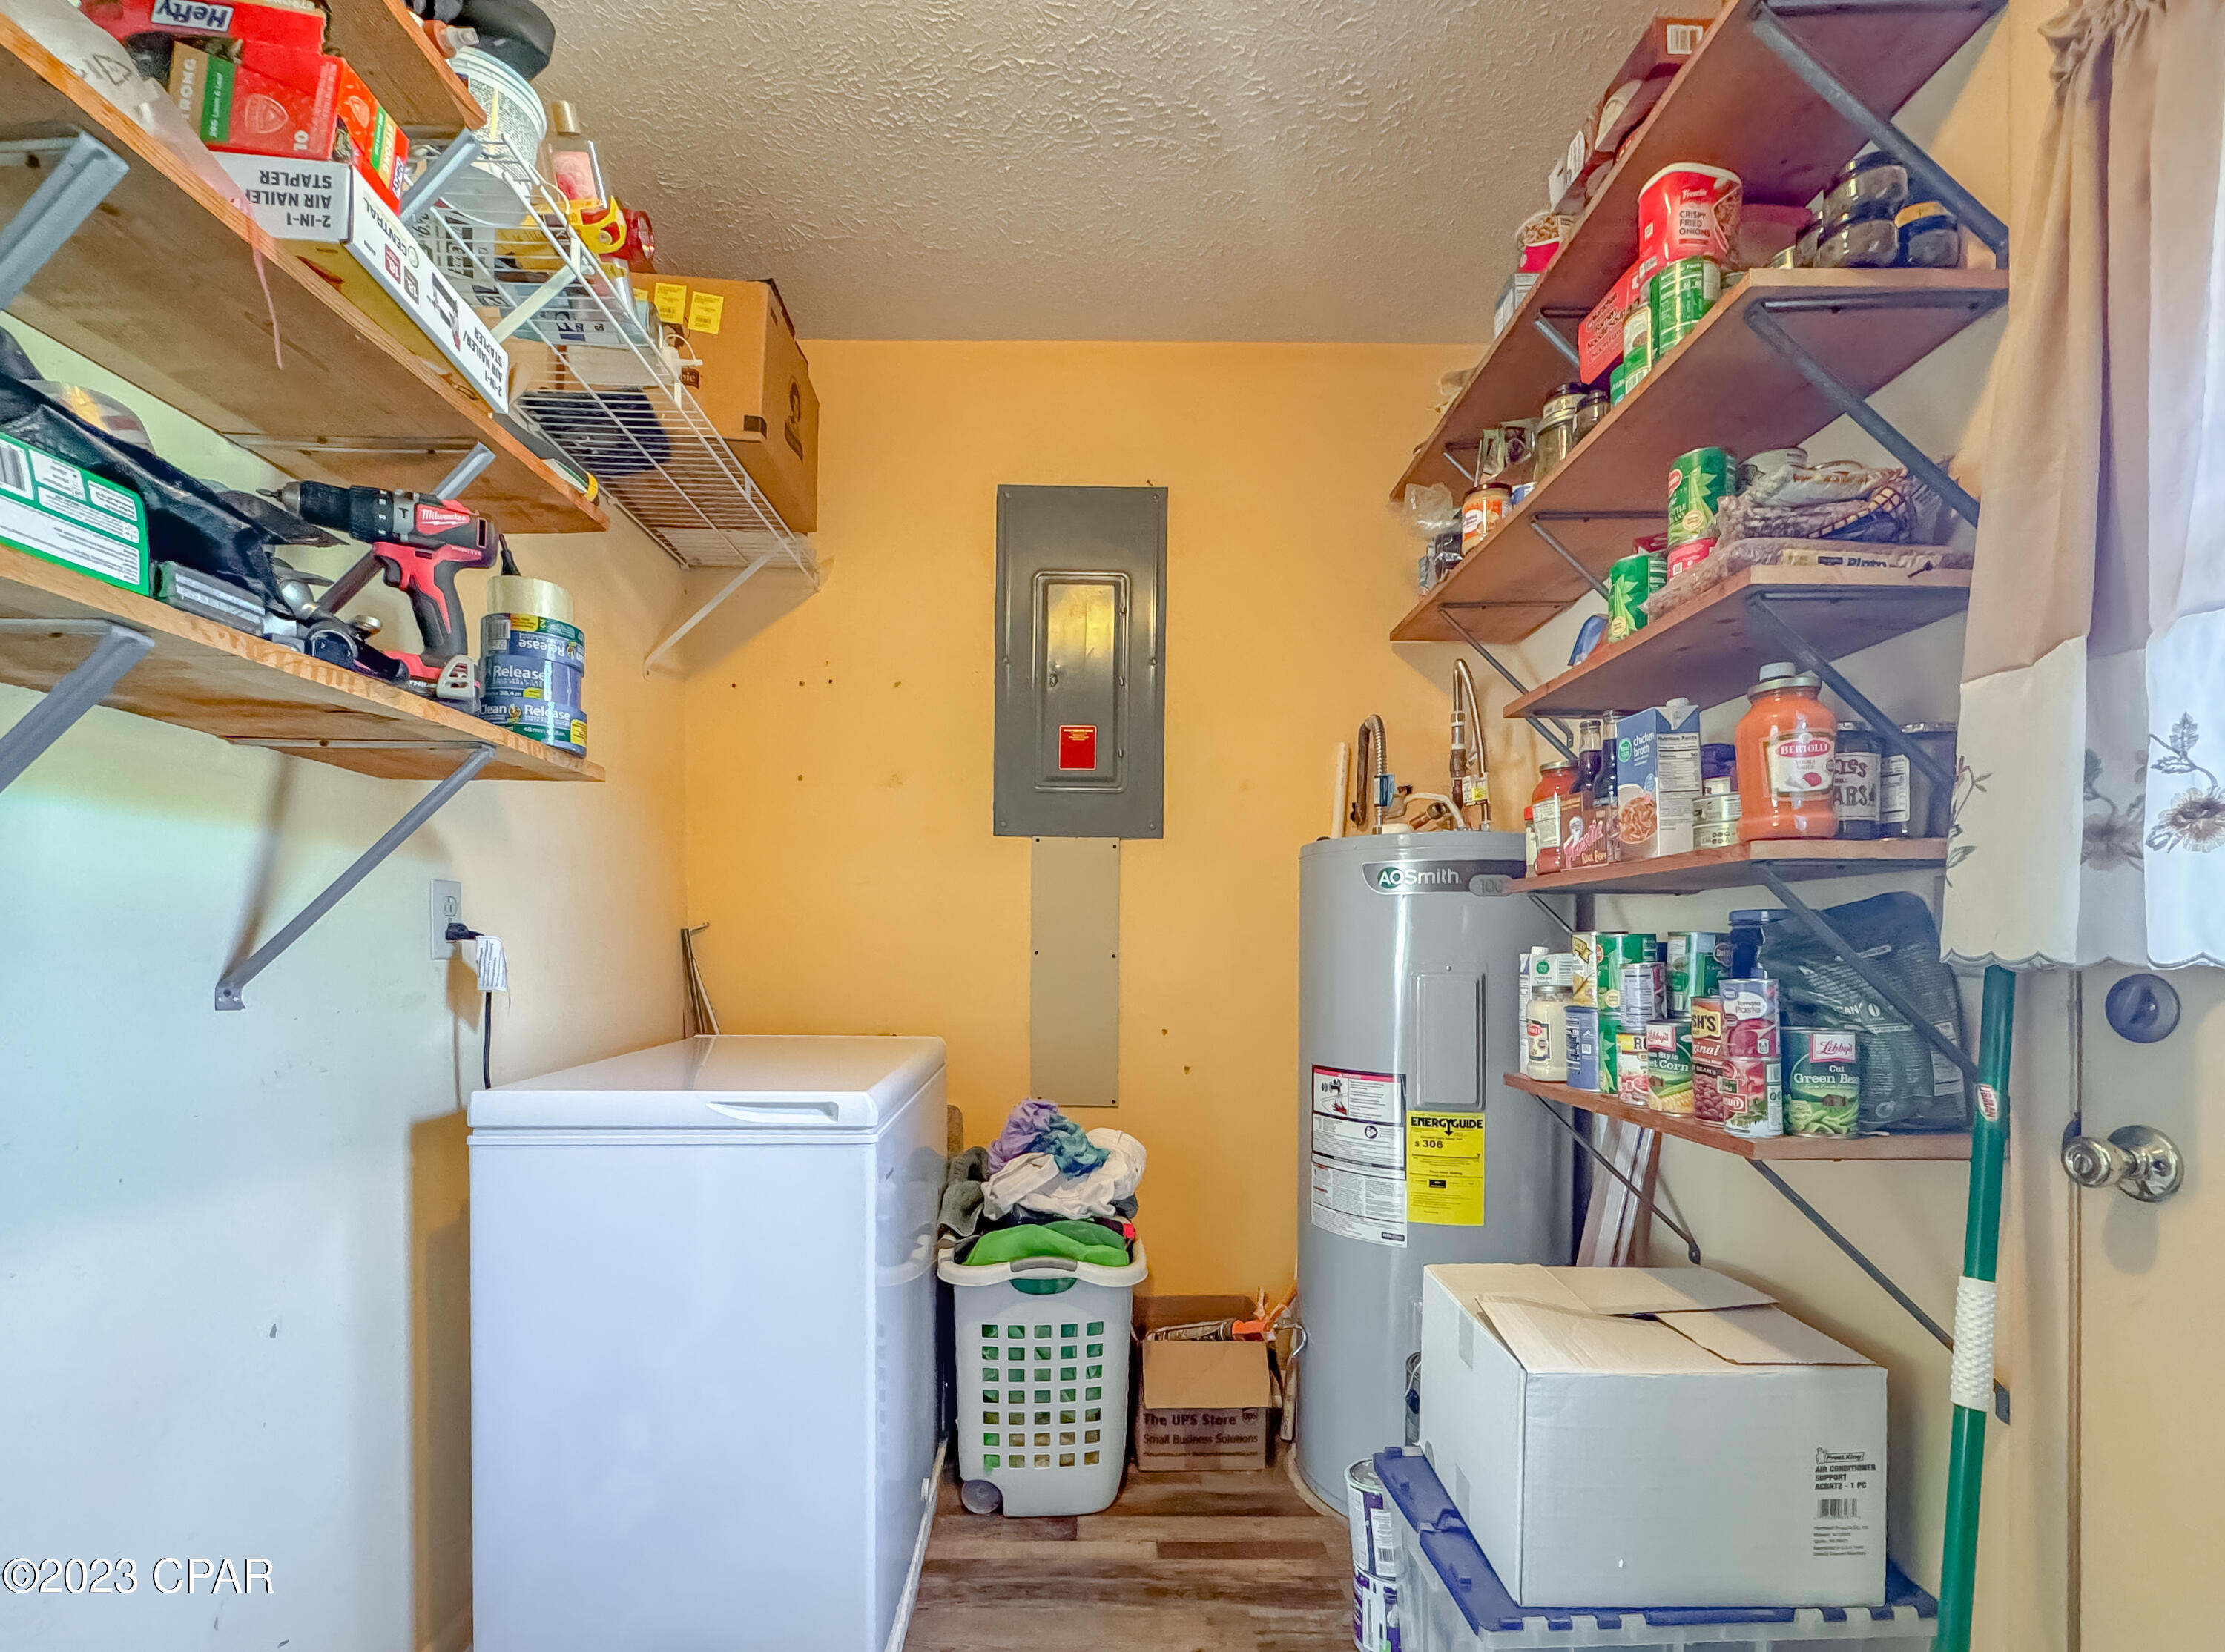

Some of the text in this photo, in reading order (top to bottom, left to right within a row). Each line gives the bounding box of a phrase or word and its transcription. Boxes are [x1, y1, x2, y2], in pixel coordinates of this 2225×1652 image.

[156, 0, 228, 27] Hefty
[179, 59, 197, 120] TRONG
[293, 130, 309, 151] 10
[260, 170, 332, 190] STAPLER
[304, 194, 332, 209] AIR
[286, 212, 332, 228] 2-IN-1
[1679, 210, 1706, 220] CRISPY
[363, 197, 407, 257] CENTRAL
[1679, 219, 1703, 228] FRIED
[1679, 227, 1710, 237] ONIONS
[421, 508, 467, 521] Milwaukee
[519, 639, 564, 657] Release
[492, 665, 545, 681] Release
[1633, 731, 1655, 746] chicken
[1634, 744, 1650, 757] broth
[1781, 742, 1828, 755] BERTOLLI
[1833, 786, 1868, 807] ARS
[1736, 1005, 1761, 1014] Paste
[1692, 1014, 1716, 1031] SH'S
[1692, 1042, 1721, 1056] ginal
[1817, 1040, 1853, 1055] Libby's
[1658, 1051, 1679, 1060] Style
[1659, 1059, 1689, 1072] Corn
[1829, 1065, 1845, 1073] Cut
[1793, 1073, 1836, 1084] Green
[1422, 1139, 1443, 1149] 306
[1144, 1413, 1236, 1426] The UPS Store
[1144, 1433, 1258, 1444] Small Business Solutions
[1829, 1464, 1876, 1472] CONDITIONER
[1815, 1473, 1847, 1481] SUPPORT
